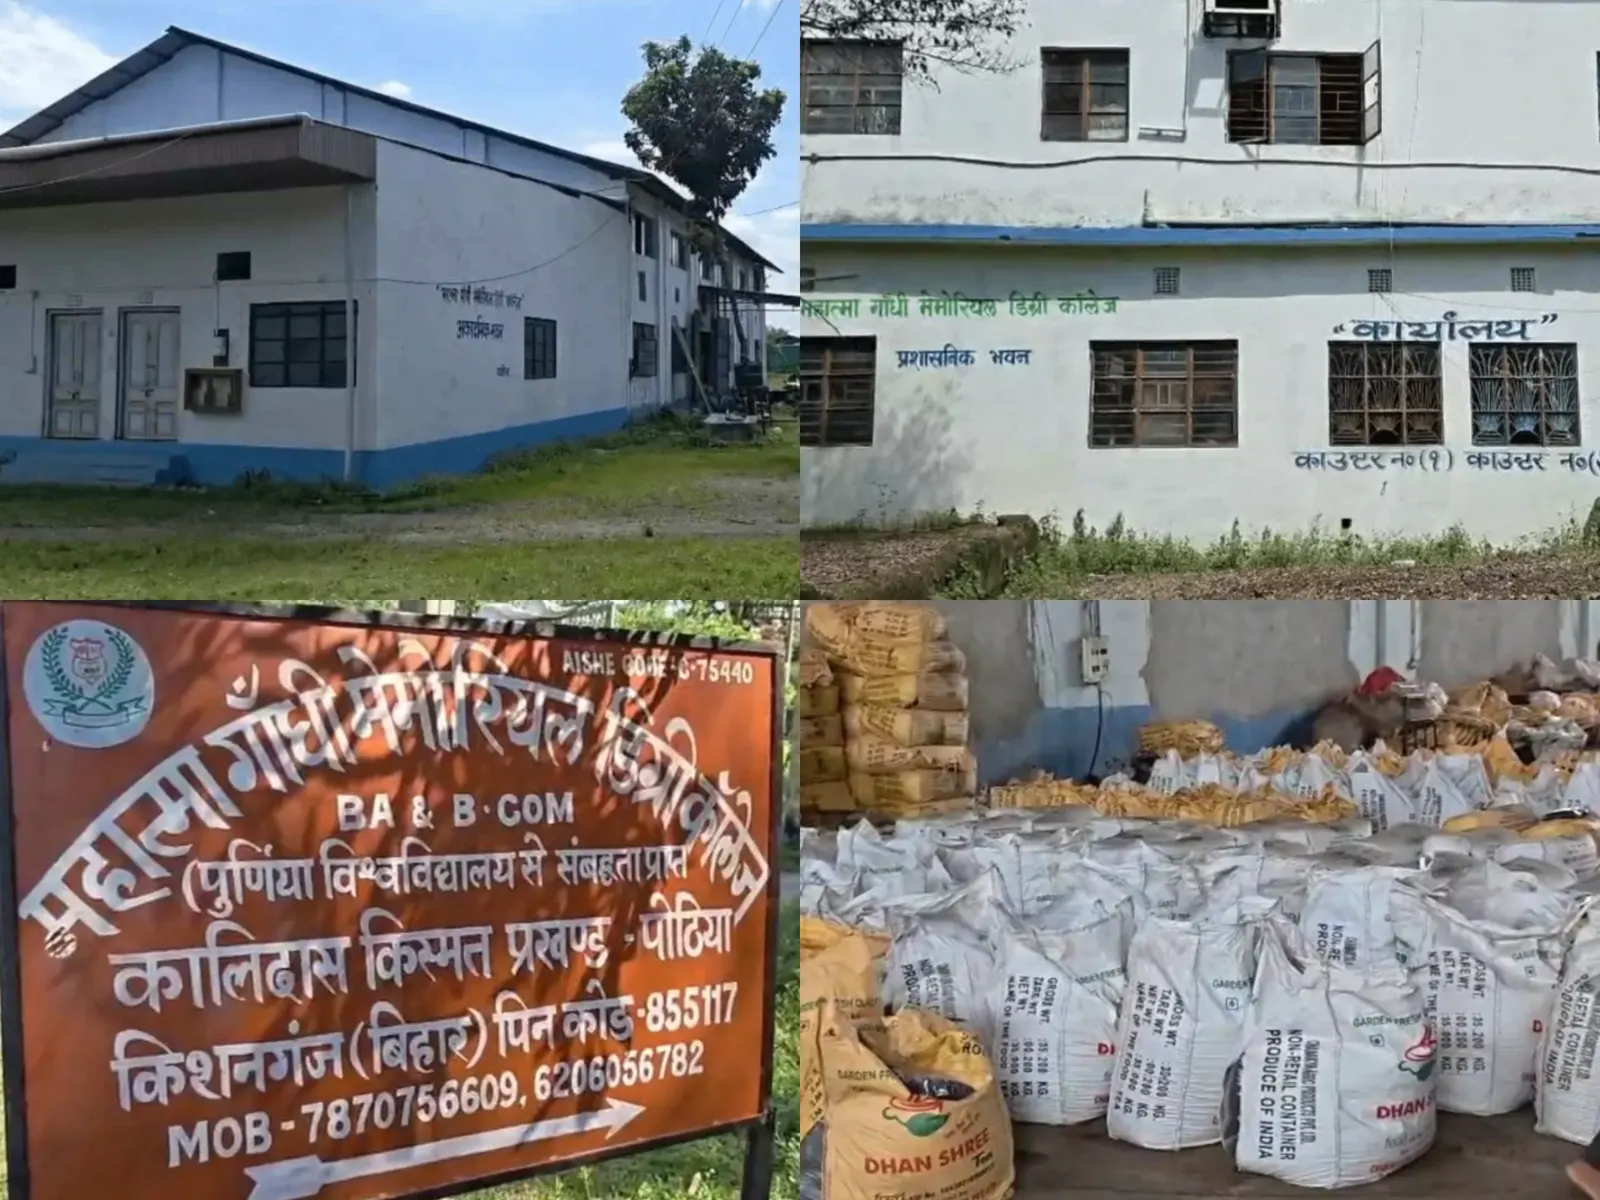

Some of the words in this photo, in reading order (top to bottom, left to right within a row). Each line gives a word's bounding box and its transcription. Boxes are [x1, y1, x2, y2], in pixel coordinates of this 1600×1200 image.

[918, 289, 1002, 319] मेमोरियल
[895, 343, 977, 371] प्रशासनिक
[989, 349, 1033, 366] भवन
[563, 650, 616, 676] AISHE
[19, 744, 245, 958] महात्मा
[337, 639, 594, 767] मेमोरियल
[337, 793, 394, 831] BA
[412, 795, 434, 829] &
[319, 836, 516, 899] विश्वविद्यालय
[519, 832, 547, 888] से
[108, 920, 351, 1013] कालिदास
[360, 907, 492, 991] किस्मत
[639, 891, 733, 961] पोठिया
[1427, 951, 1441, 978] NME
[1042, 977, 1058, 1007] GROSS
[1157, 989, 1172, 1020] TARE
[110, 1020, 344, 1112] किशनगंज
[351, 1001, 487, 1080] (बिहार)
[493, 990, 557, 1058] पिन
[1126, 1032, 1138, 1052] THE
[1281, 1029, 1303, 1092] NON-RETAIL
[1120, 1054, 1133, 1081] FOOD
[1260, 1029, 1282, 1093] PRODUCE
[1545, 1049, 1558, 1085] INDIA
[168, 1111, 272, 1168] MOB
[534, 1040, 705, 1099] 6206056782
[1260, 1098, 1275, 1117] OF
[1376, 1098, 1425, 1119] DHAN
[1258, 1120, 1274, 1159] INDIA
[1280, 1095, 1297, 1161] CONTAINER
[864, 1154, 932, 1175] DHAN
[938, 1127, 991, 1167] SHREE
